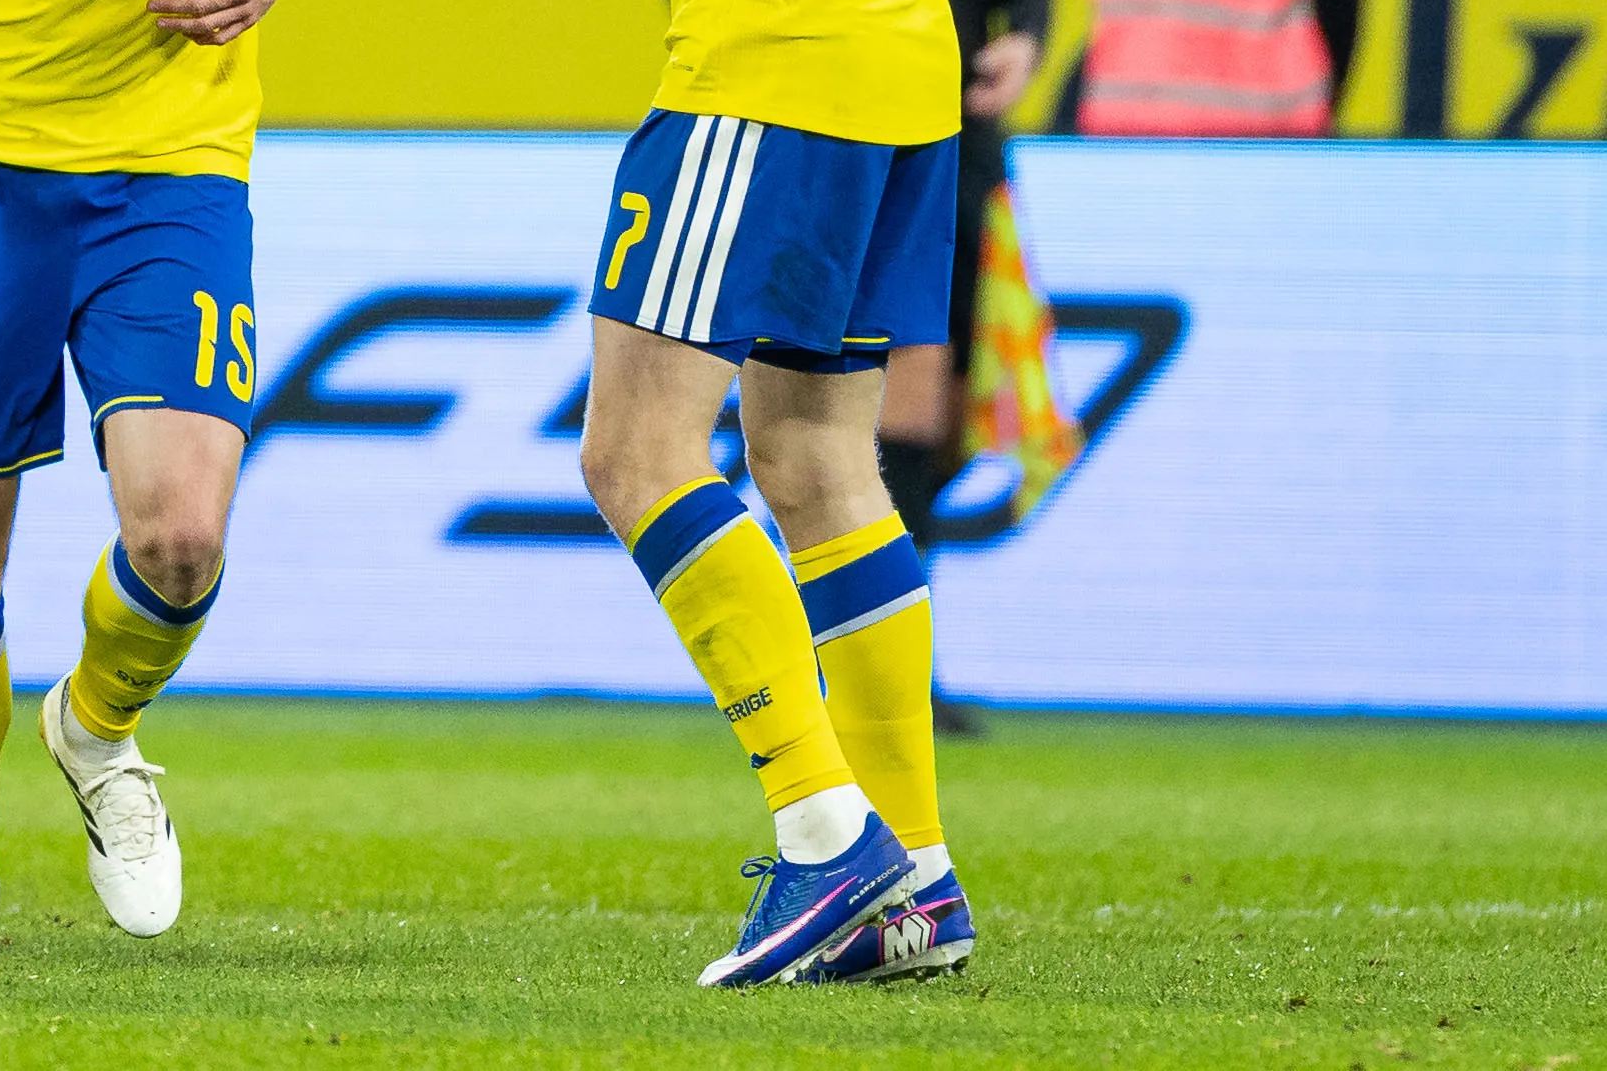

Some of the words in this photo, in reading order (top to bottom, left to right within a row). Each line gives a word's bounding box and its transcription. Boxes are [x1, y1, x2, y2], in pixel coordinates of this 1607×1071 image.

[604, 191, 651, 290] 7
[192, 290, 254, 403] 15
[723, 686, 773, 723] ERIGE
